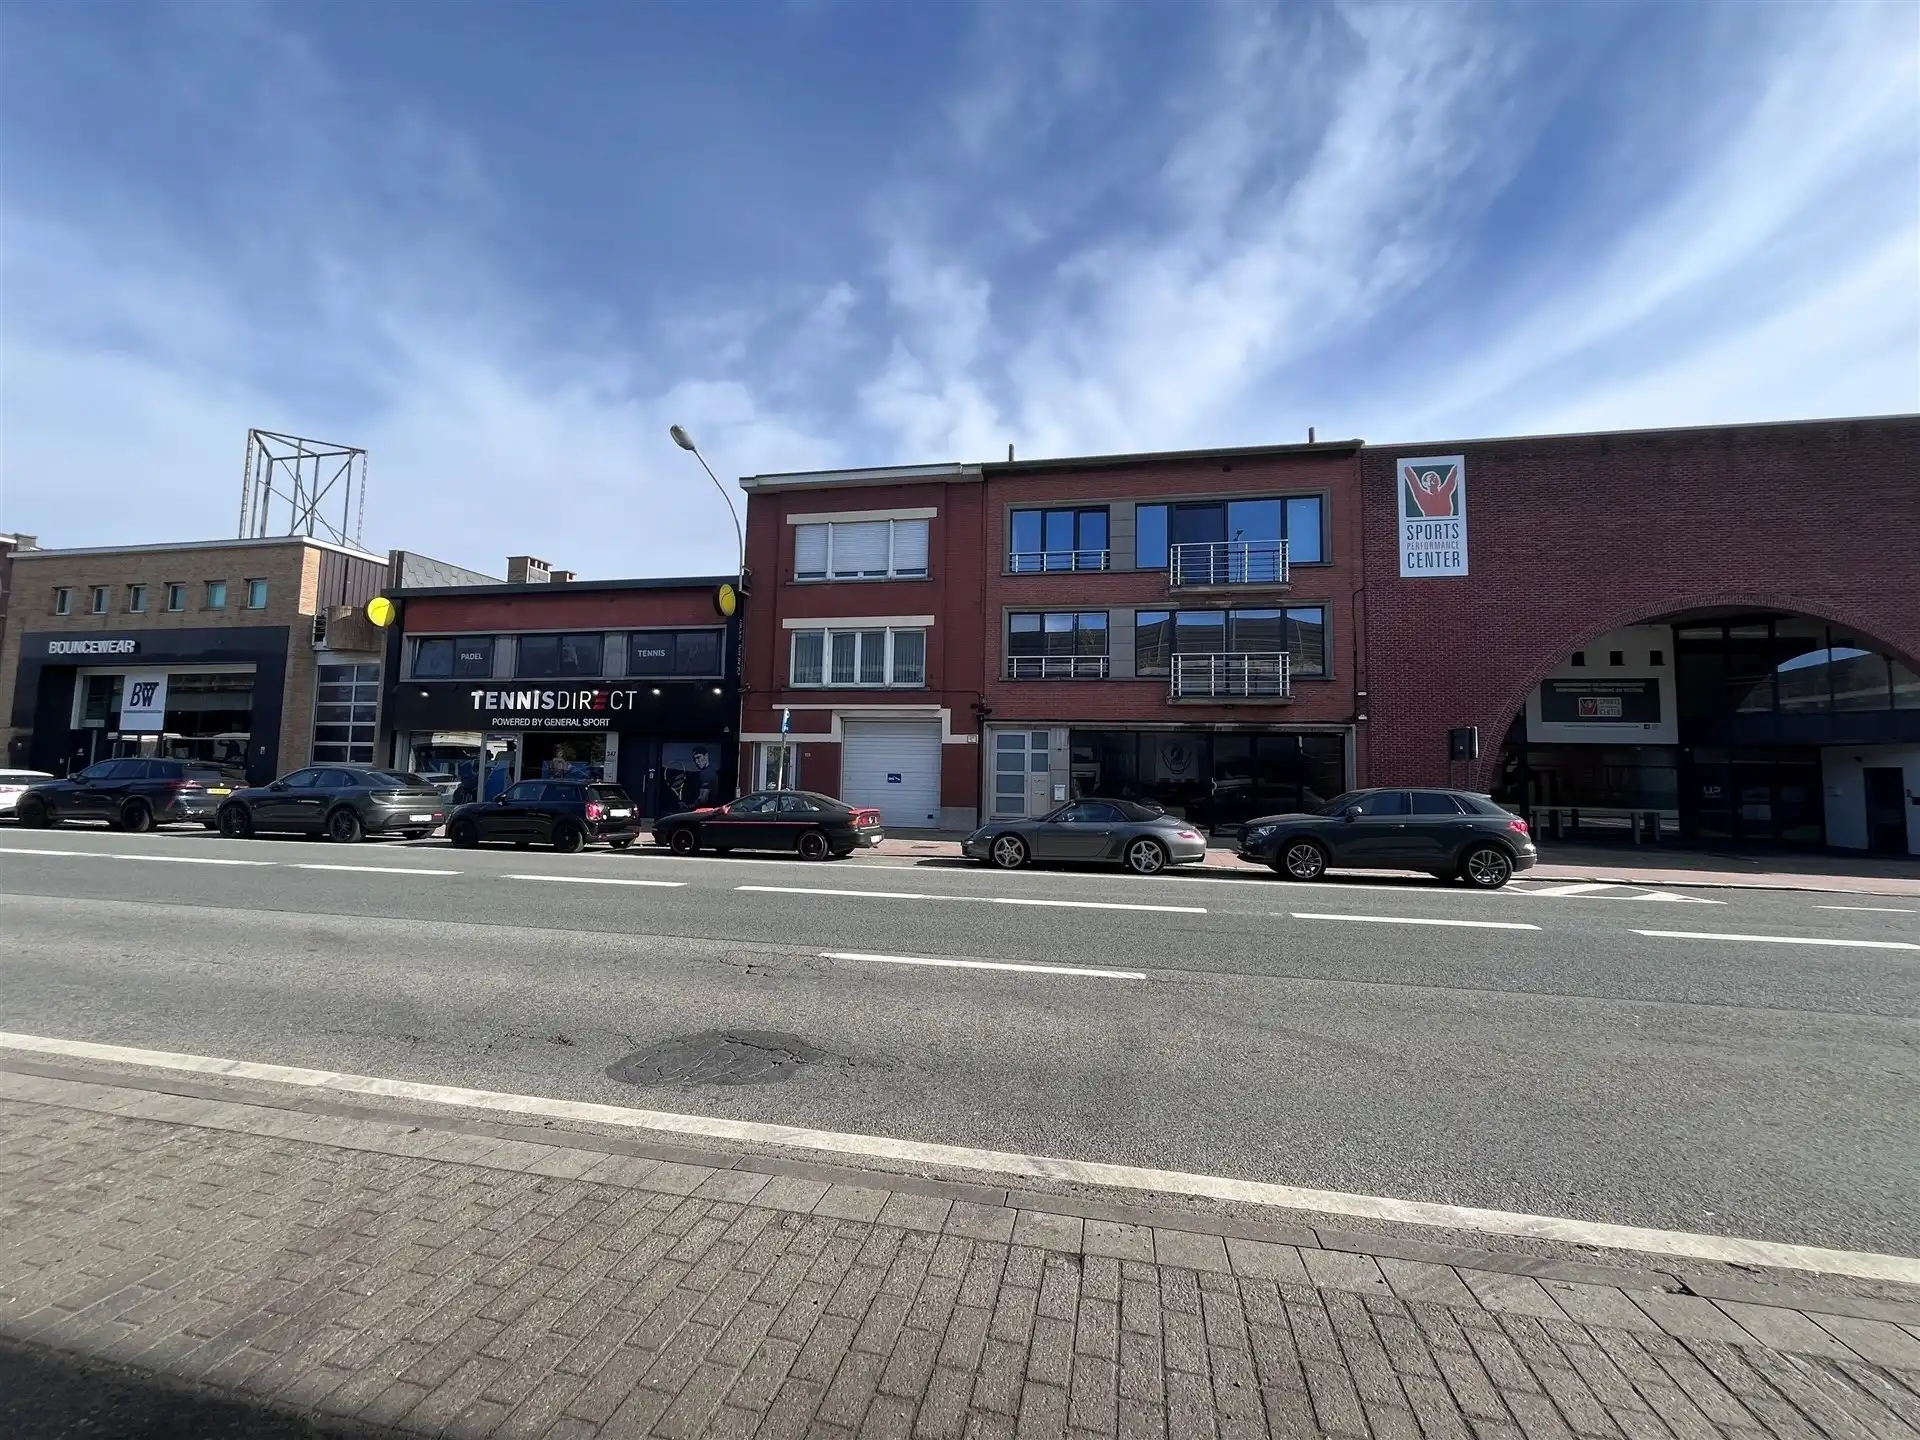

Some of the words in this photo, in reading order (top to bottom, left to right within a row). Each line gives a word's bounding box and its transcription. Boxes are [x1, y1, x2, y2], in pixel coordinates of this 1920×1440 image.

[1407, 523, 1459, 540] SPORTS
[1407, 541, 1459, 550] PERFORMANCE
[1407, 551, 1460, 568] CENTER
[48, 640, 136, 654] BOUNCEWEAR
[637, 649, 666, 657] TENNIS
[460, 652, 483, 660] PADEL
[129, 681, 160, 707] BW
[471, 690, 638, 710] TENNISDIRECT
[492, 718, 531, 726] POWERED
[532, 718, 543, 726] BY
[544, 718, 581, 726] GENERAL
[582, 718, 610, 727] SPORT
